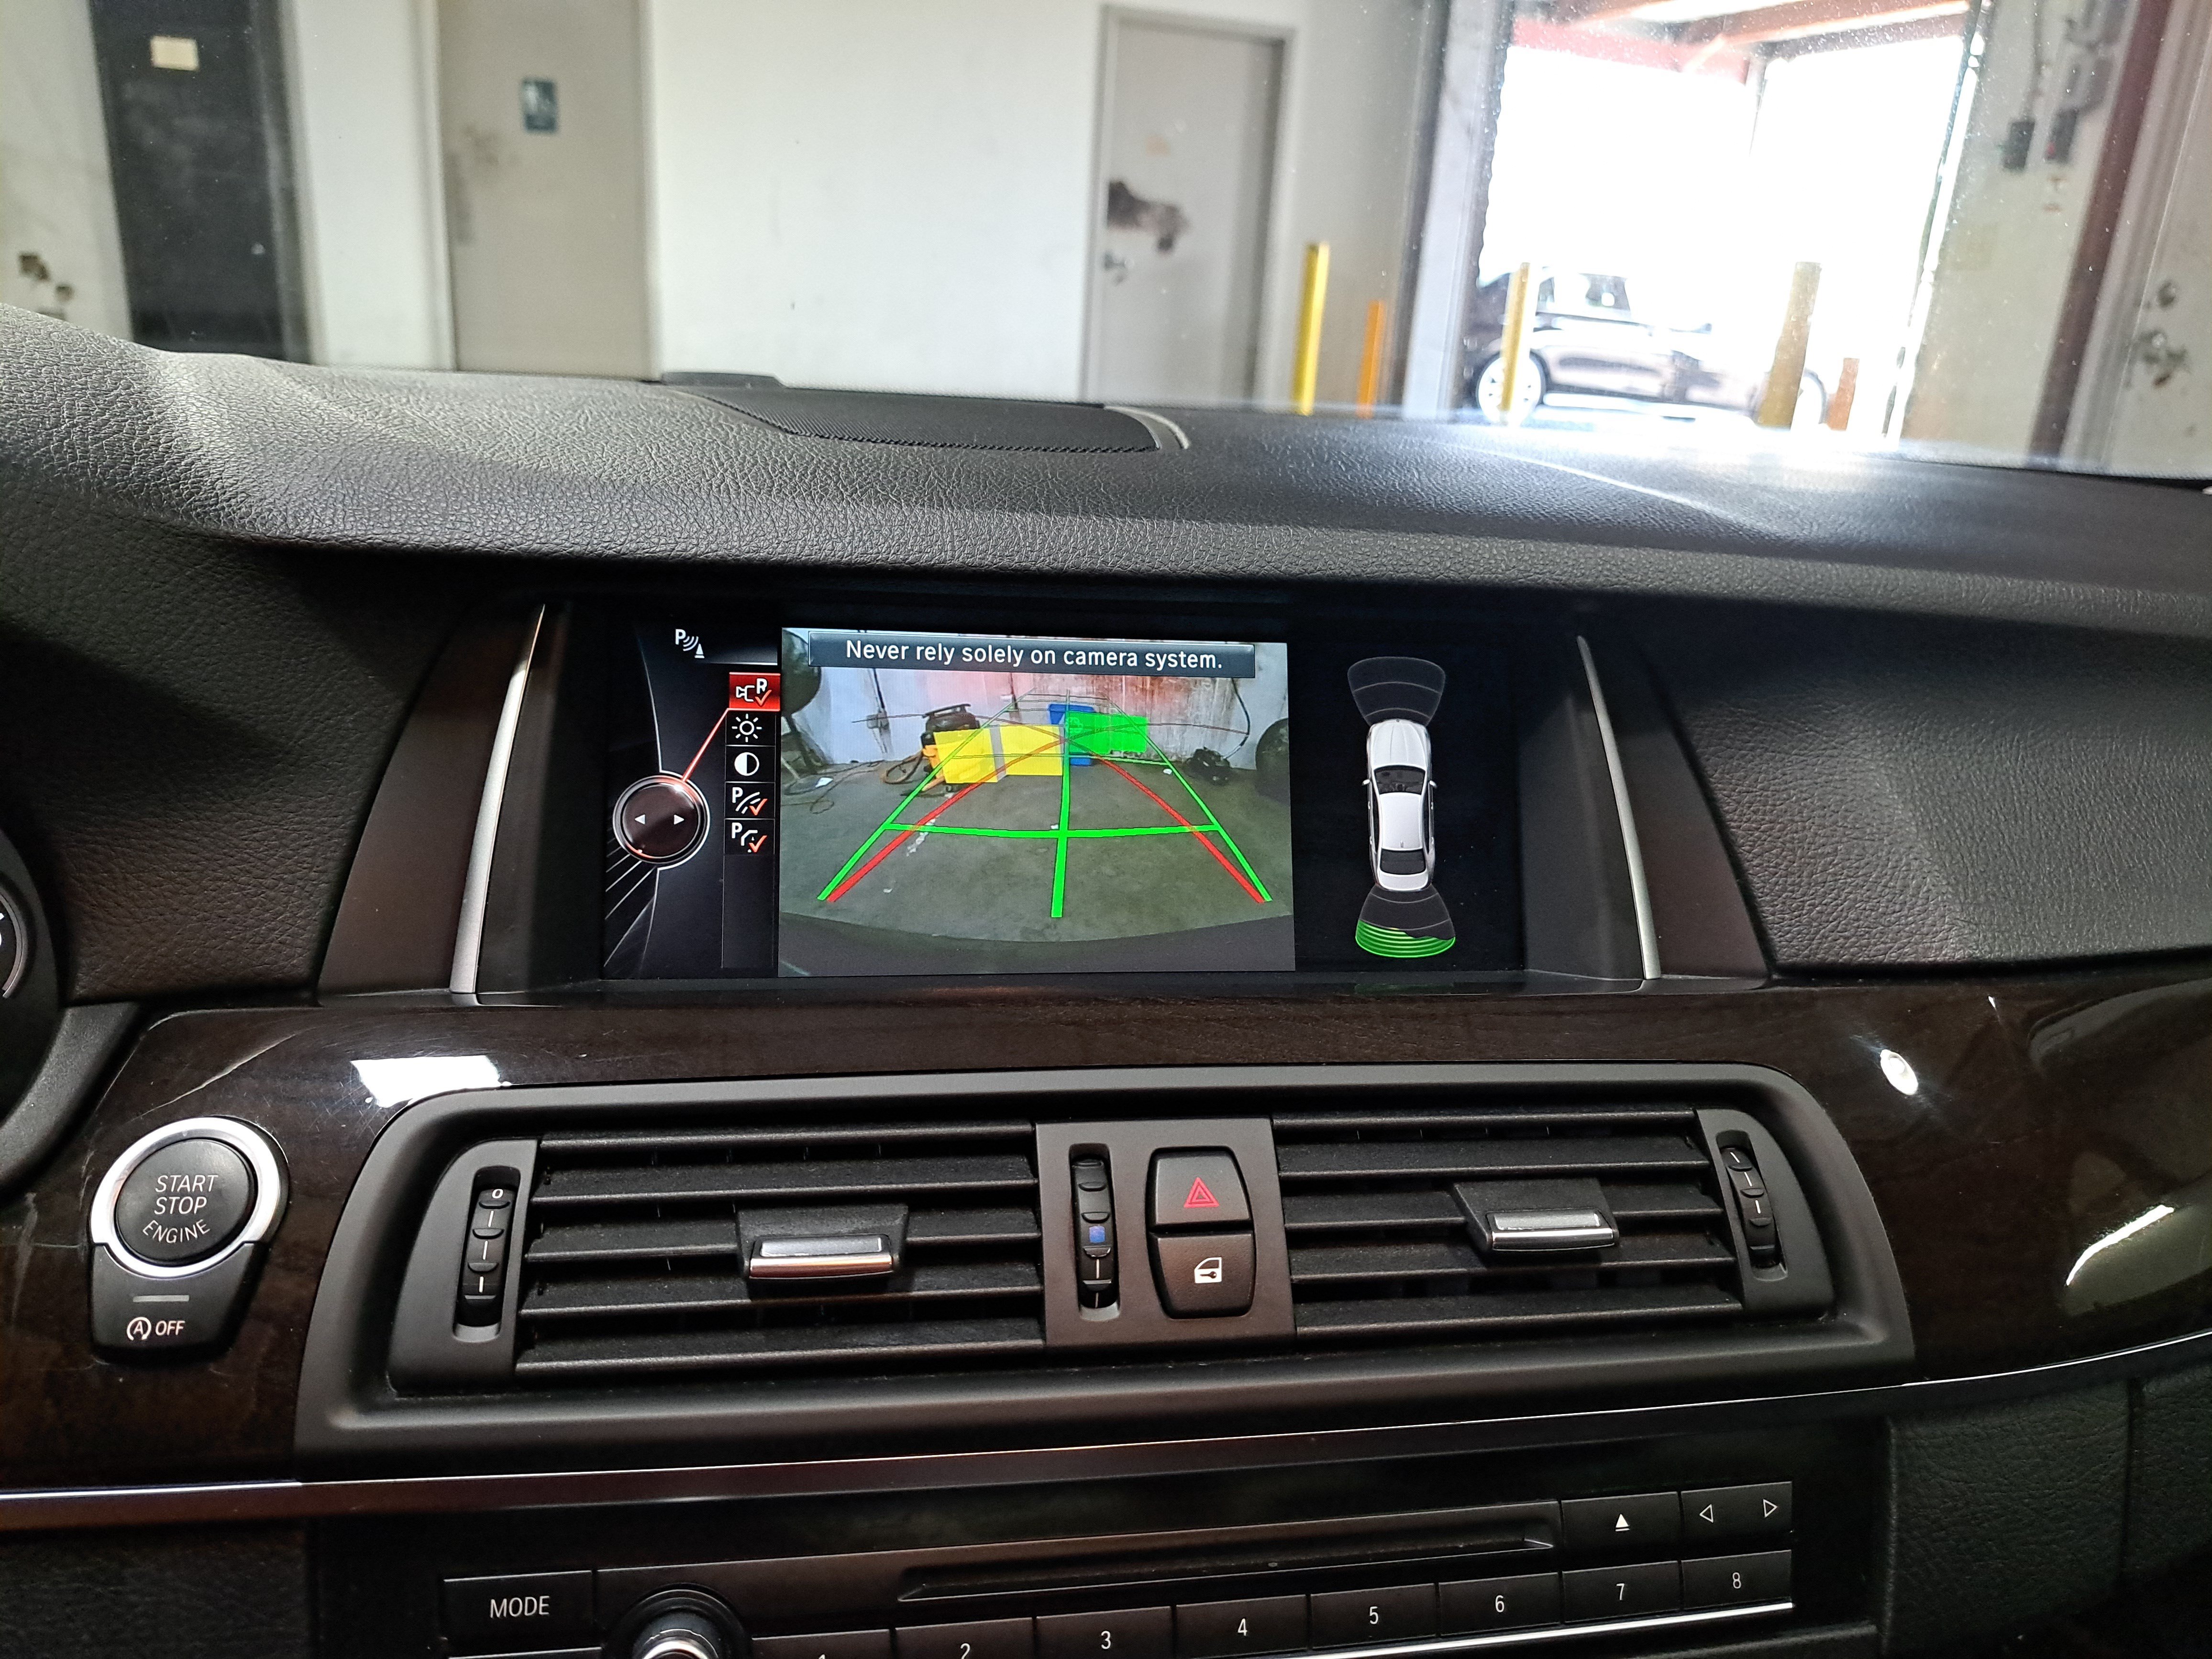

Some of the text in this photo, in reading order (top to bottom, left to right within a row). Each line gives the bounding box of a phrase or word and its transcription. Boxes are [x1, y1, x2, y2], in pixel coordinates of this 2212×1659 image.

[846, 640, 1223, 671] Never rely solely on camera system.
[155, 1174, 219, 1193] START
[154, 1196, 207, 1215] STOP
[143, 1219, 210, 1243] ENGINE
[155, 1320, 185, 1336] OFF
[1732, 1572, 1741, 1589] 8
[1616, 1583, 1625, 1601] 7
[490, 1595, 550, 1618] MODE
[1495, 1595, 1505, 1613] 6
[1370, 1606, 1379, 1625] 5
[1238, 1618, 1248, 1636] 4
[1100, 1630, 1112, 1649] 3
[960, 1643, 971, 1659] 2
